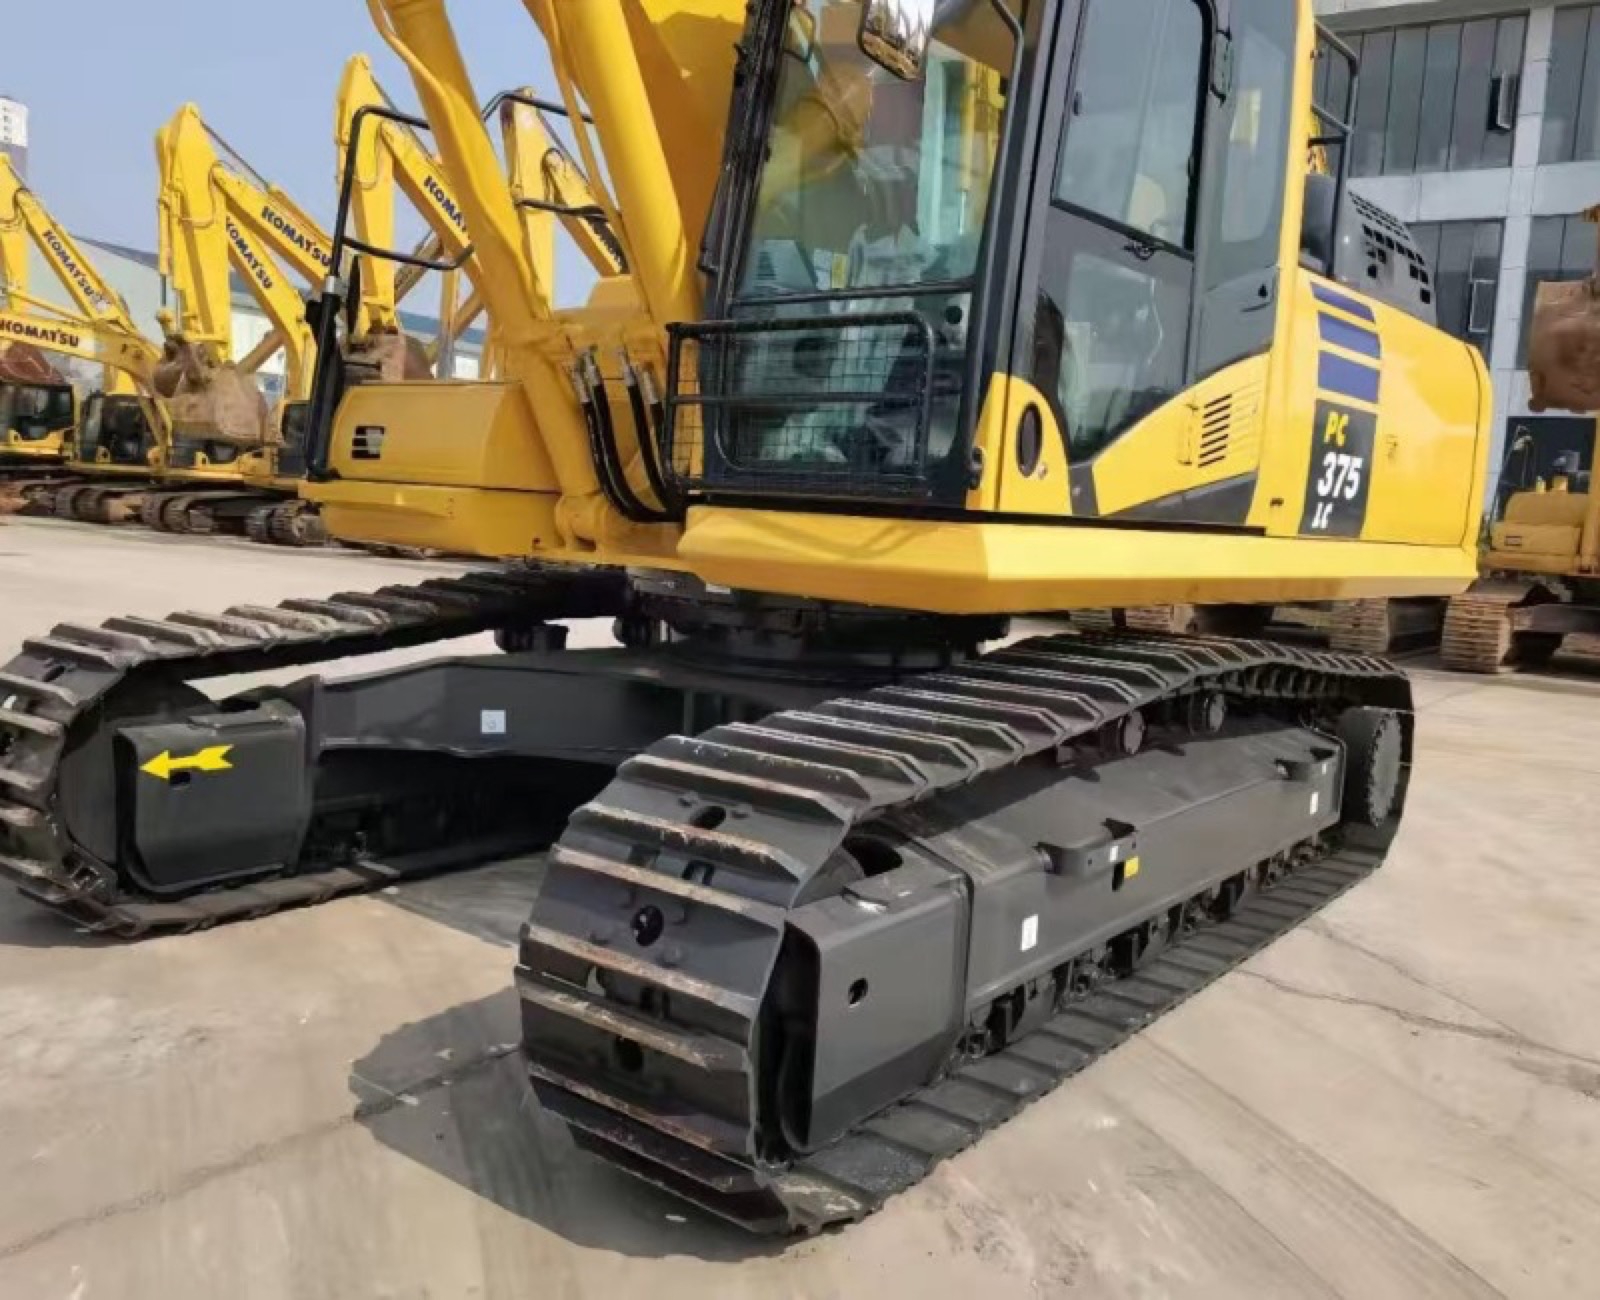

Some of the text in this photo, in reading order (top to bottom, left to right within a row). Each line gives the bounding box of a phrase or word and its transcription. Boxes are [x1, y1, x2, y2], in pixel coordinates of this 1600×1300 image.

[43, 229, 95, 296] KOMATSU
[0, 318, 79, 347] KOMATSU
[1323, 410, 1349, 447] PC
[1317, 450, 1363, 500] 375
